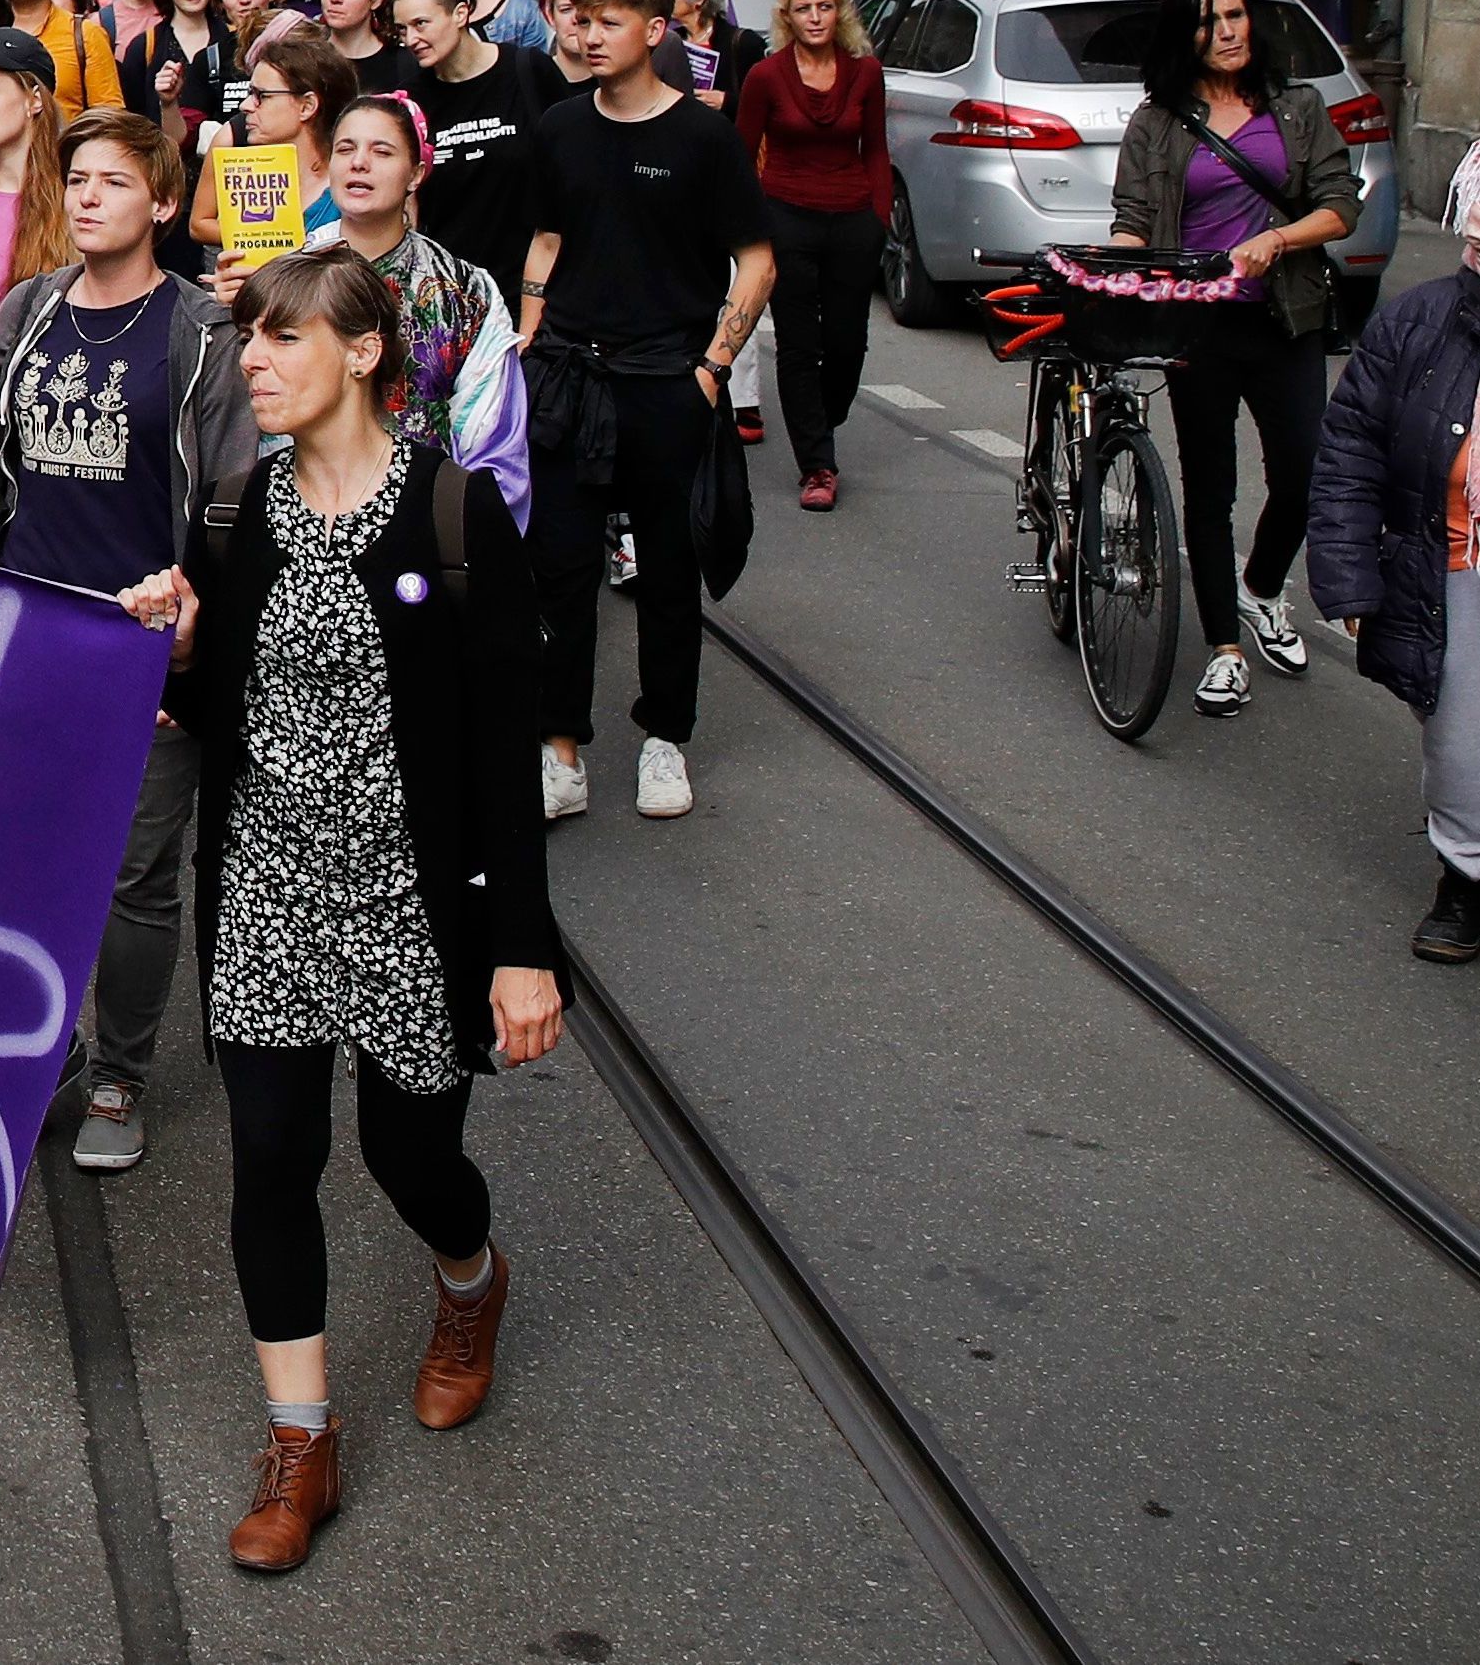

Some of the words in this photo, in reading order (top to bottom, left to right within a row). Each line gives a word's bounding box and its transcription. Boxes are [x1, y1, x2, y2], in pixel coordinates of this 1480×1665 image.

[479, 117, 501, 129] INS
[1079, 109, 1109, 127] art
[634, 161, 671, 179] impro
[224, 173, 290, 190] FRAUEN
[230, 191, 287, 213] STREIK
[233, 239, 294, 249] PROGRAMM
[40, 462, 70, 477] MUSIC
[74, 466, 125, 481] FESTIVAL
